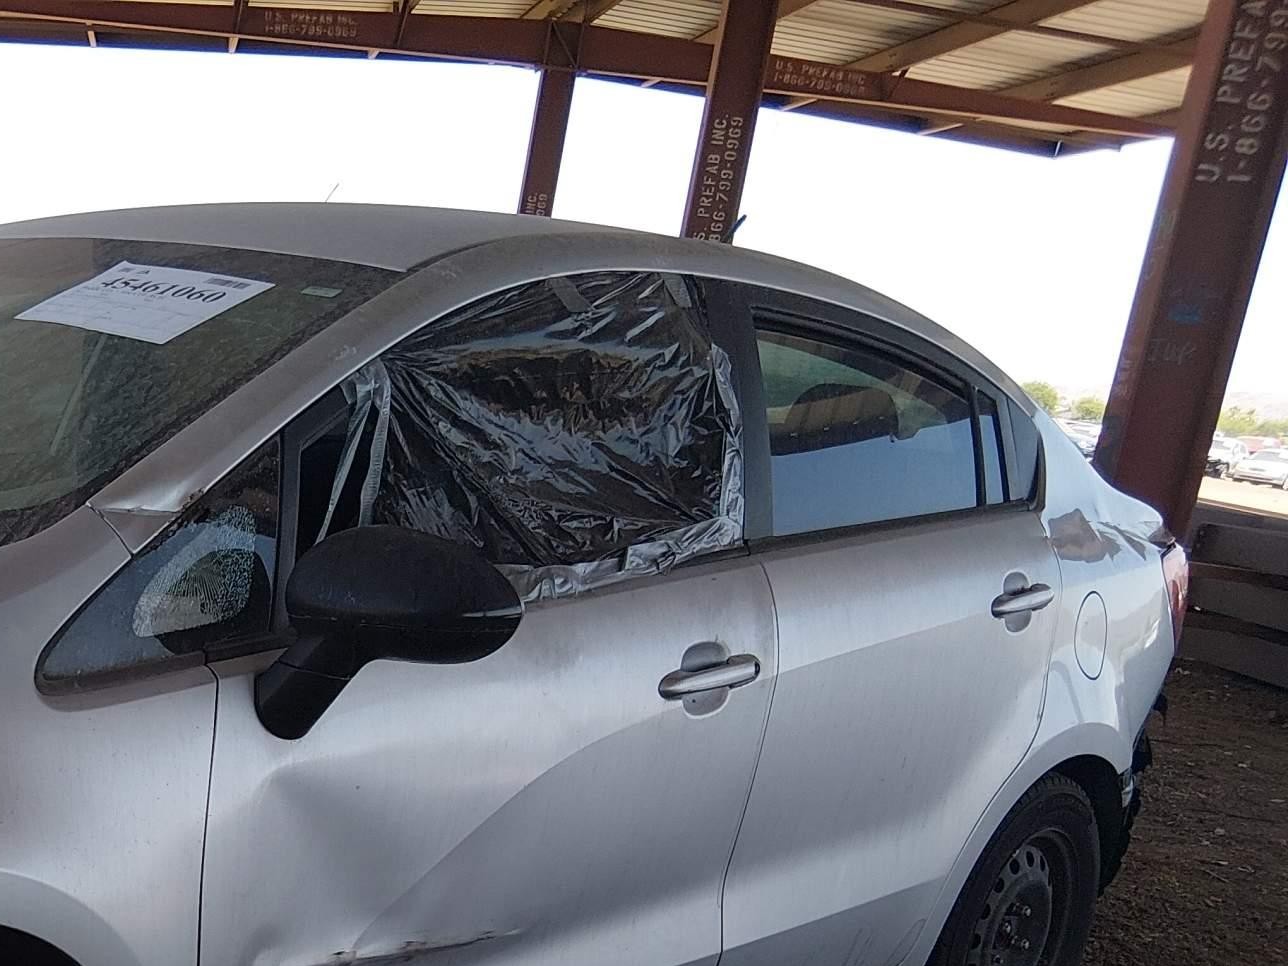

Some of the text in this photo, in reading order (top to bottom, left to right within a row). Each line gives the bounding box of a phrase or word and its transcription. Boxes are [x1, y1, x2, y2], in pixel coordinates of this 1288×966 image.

[697, 154, 721, 217] PREFAB
[710, 114, 729, 145] INC.
[1195, 125, 1233, 182] U.S.
[101, 277, 227, 303] 45461060
